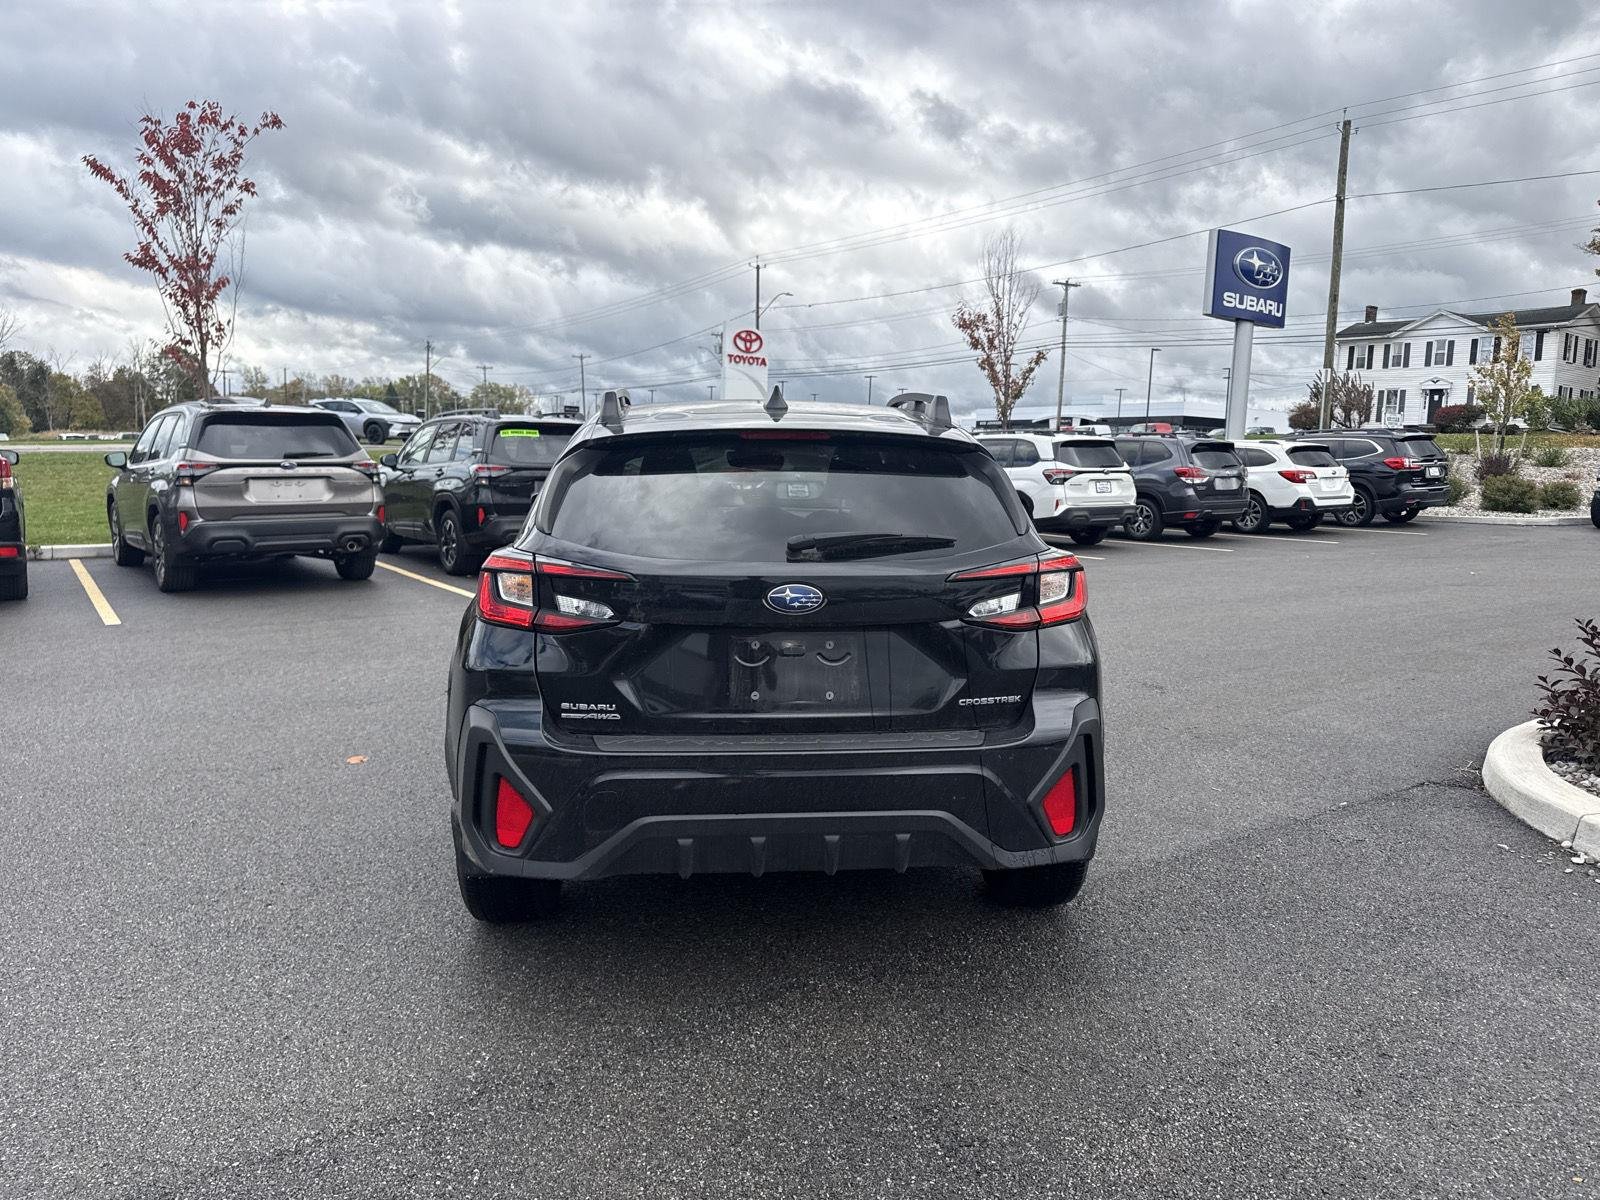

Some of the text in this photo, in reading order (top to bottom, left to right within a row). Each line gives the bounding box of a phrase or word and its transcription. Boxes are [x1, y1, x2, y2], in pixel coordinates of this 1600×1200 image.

[1222, 291, 1283, 317] SUBARU
[727, 353, 767, 367] TOYOTA
[560, 702, 616, 711] SUBARU
[958, 694, 1021, 706] CROSSTREK
